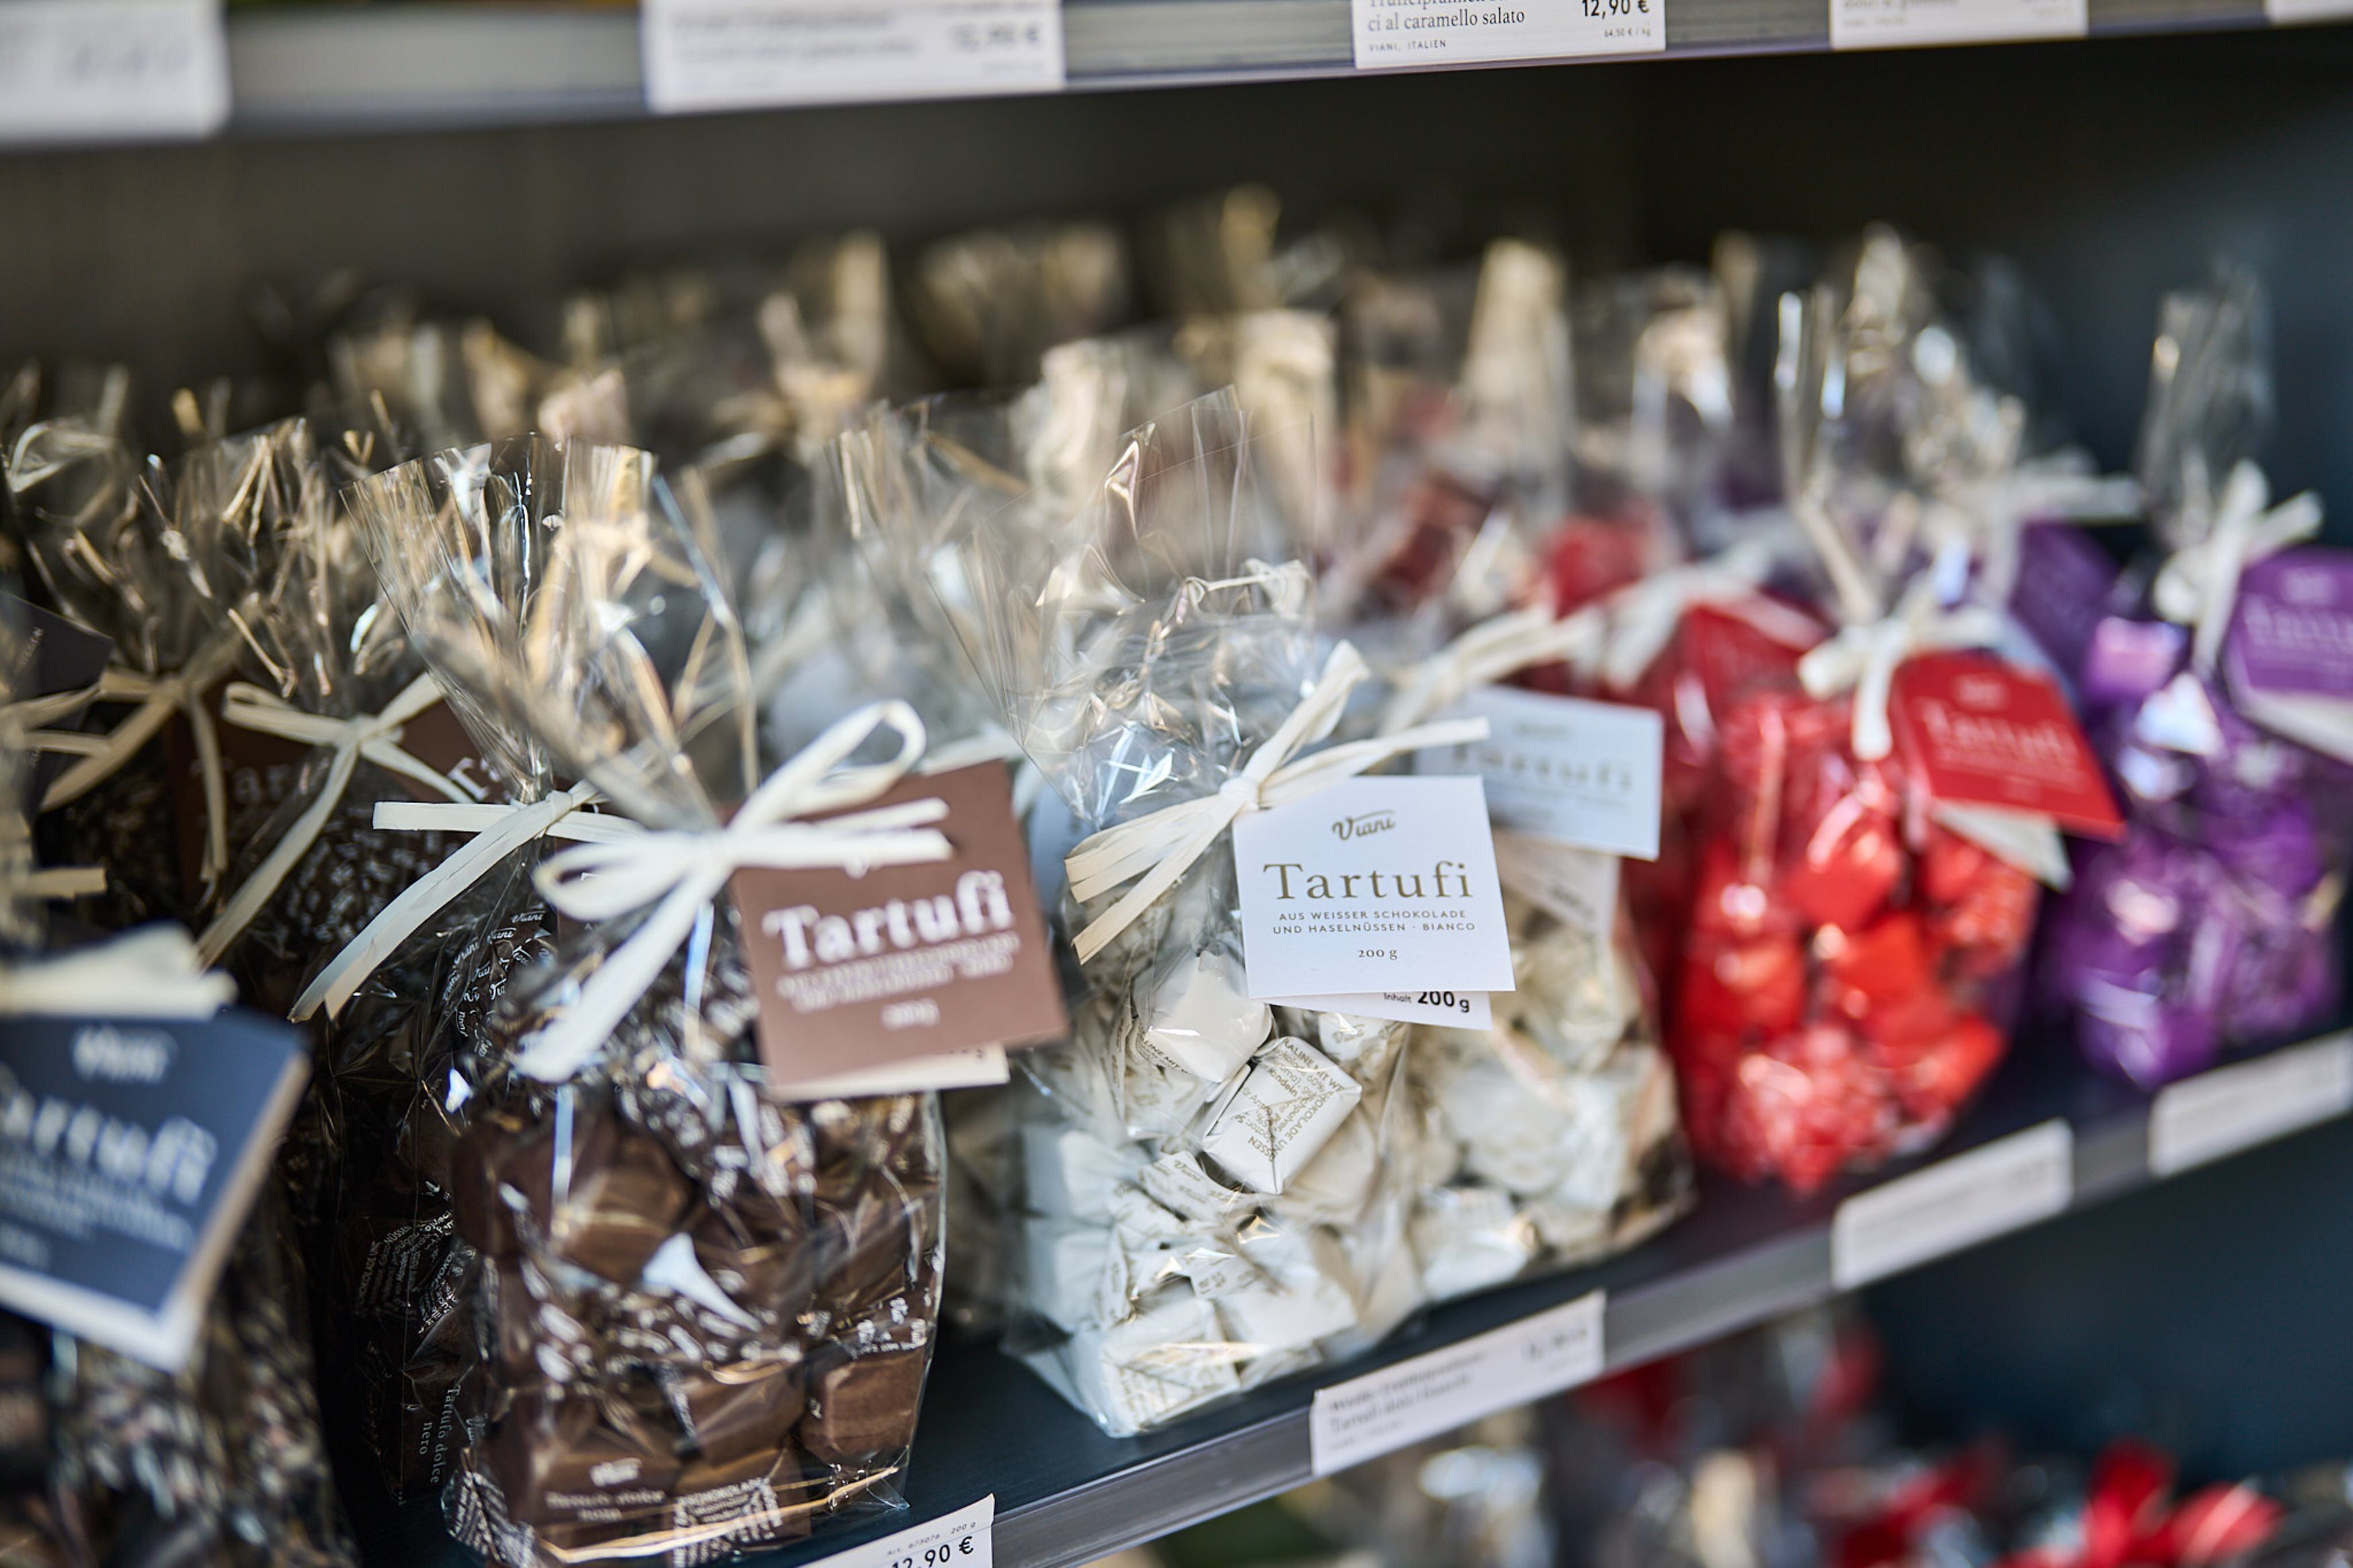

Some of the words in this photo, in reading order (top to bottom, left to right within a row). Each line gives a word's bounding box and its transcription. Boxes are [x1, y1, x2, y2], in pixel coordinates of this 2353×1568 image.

[1638, 0, 1650, 13] €
[1369, 14, 1381, 31] ci
[1386, 12, 1399, 30] al
[1404, 8, 1478, 30] caramello
[1482, 7, 1525, 25] salato
[1407, 39, 1447, 51] ITALIEN
[1332, 809, 1396, 841] Viani
[1263, 860, 1474, 900] Tartufi
[762, 870, 1015, 971] Tartufi
[1279, 912, 1305, 921] AUS
[1311, 911, 1368, 920] WEISSER
[1373, 909, 1467, 919] SCHOKOLADE
[1273, 925, 1302, 934] UND
[1309, 921, 1406, 933] HASELNÜSSEN
[1423, 922, 1476, 932] BIANCO
[1357, 948, 1386, 958] 200
[1389, 948, 1398, 960] g
[1383, 992, 1412, 1003] Inhalt
[1417, 991, 1455, 1007] 200
[1459, 999, 1470, 1013] g
[438, 1385, 461, 1440] Tartufo
[418, 1421, 433, 1456] nero
[430, 1443, 449, 1485] dolce
[958, 1536, 975, 1555] €
